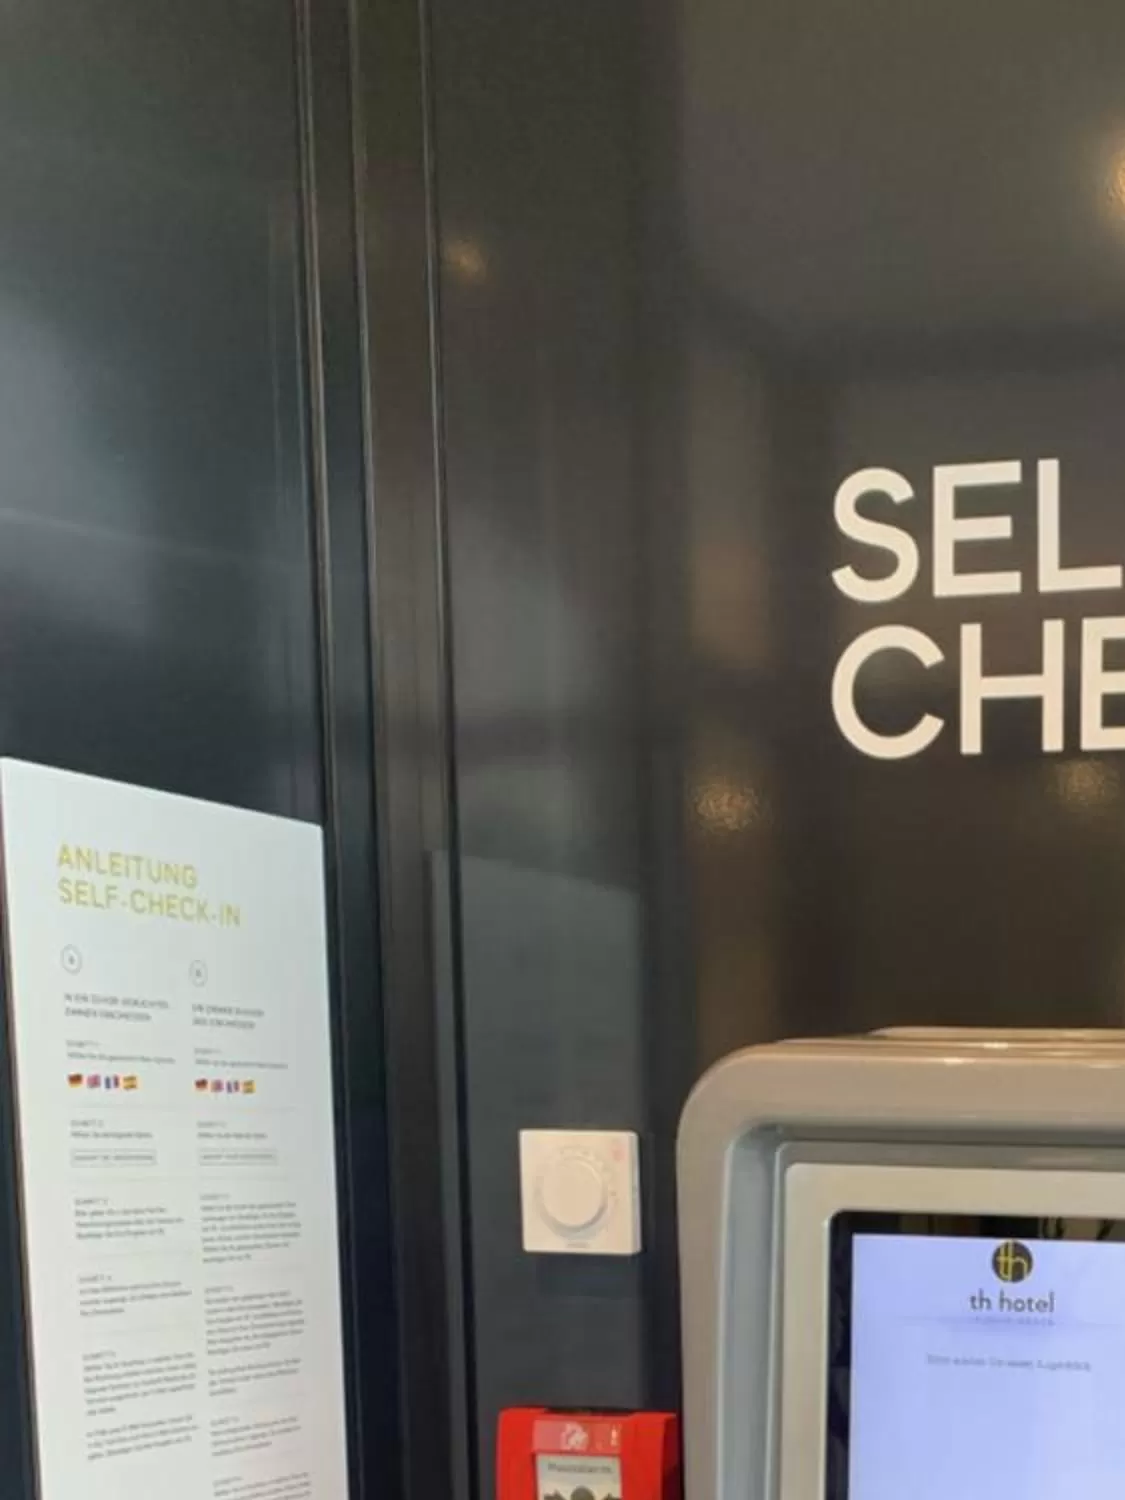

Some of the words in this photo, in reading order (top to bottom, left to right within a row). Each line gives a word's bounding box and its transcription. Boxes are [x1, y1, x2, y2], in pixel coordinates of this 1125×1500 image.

[58, 843, 198, 890] ANLEITUNG
[58, 876, 241, 928] SELF-CHECK-IN
[970, 1288, 991, 1311] th
[999, 1290, 1055, 1313] hotel
